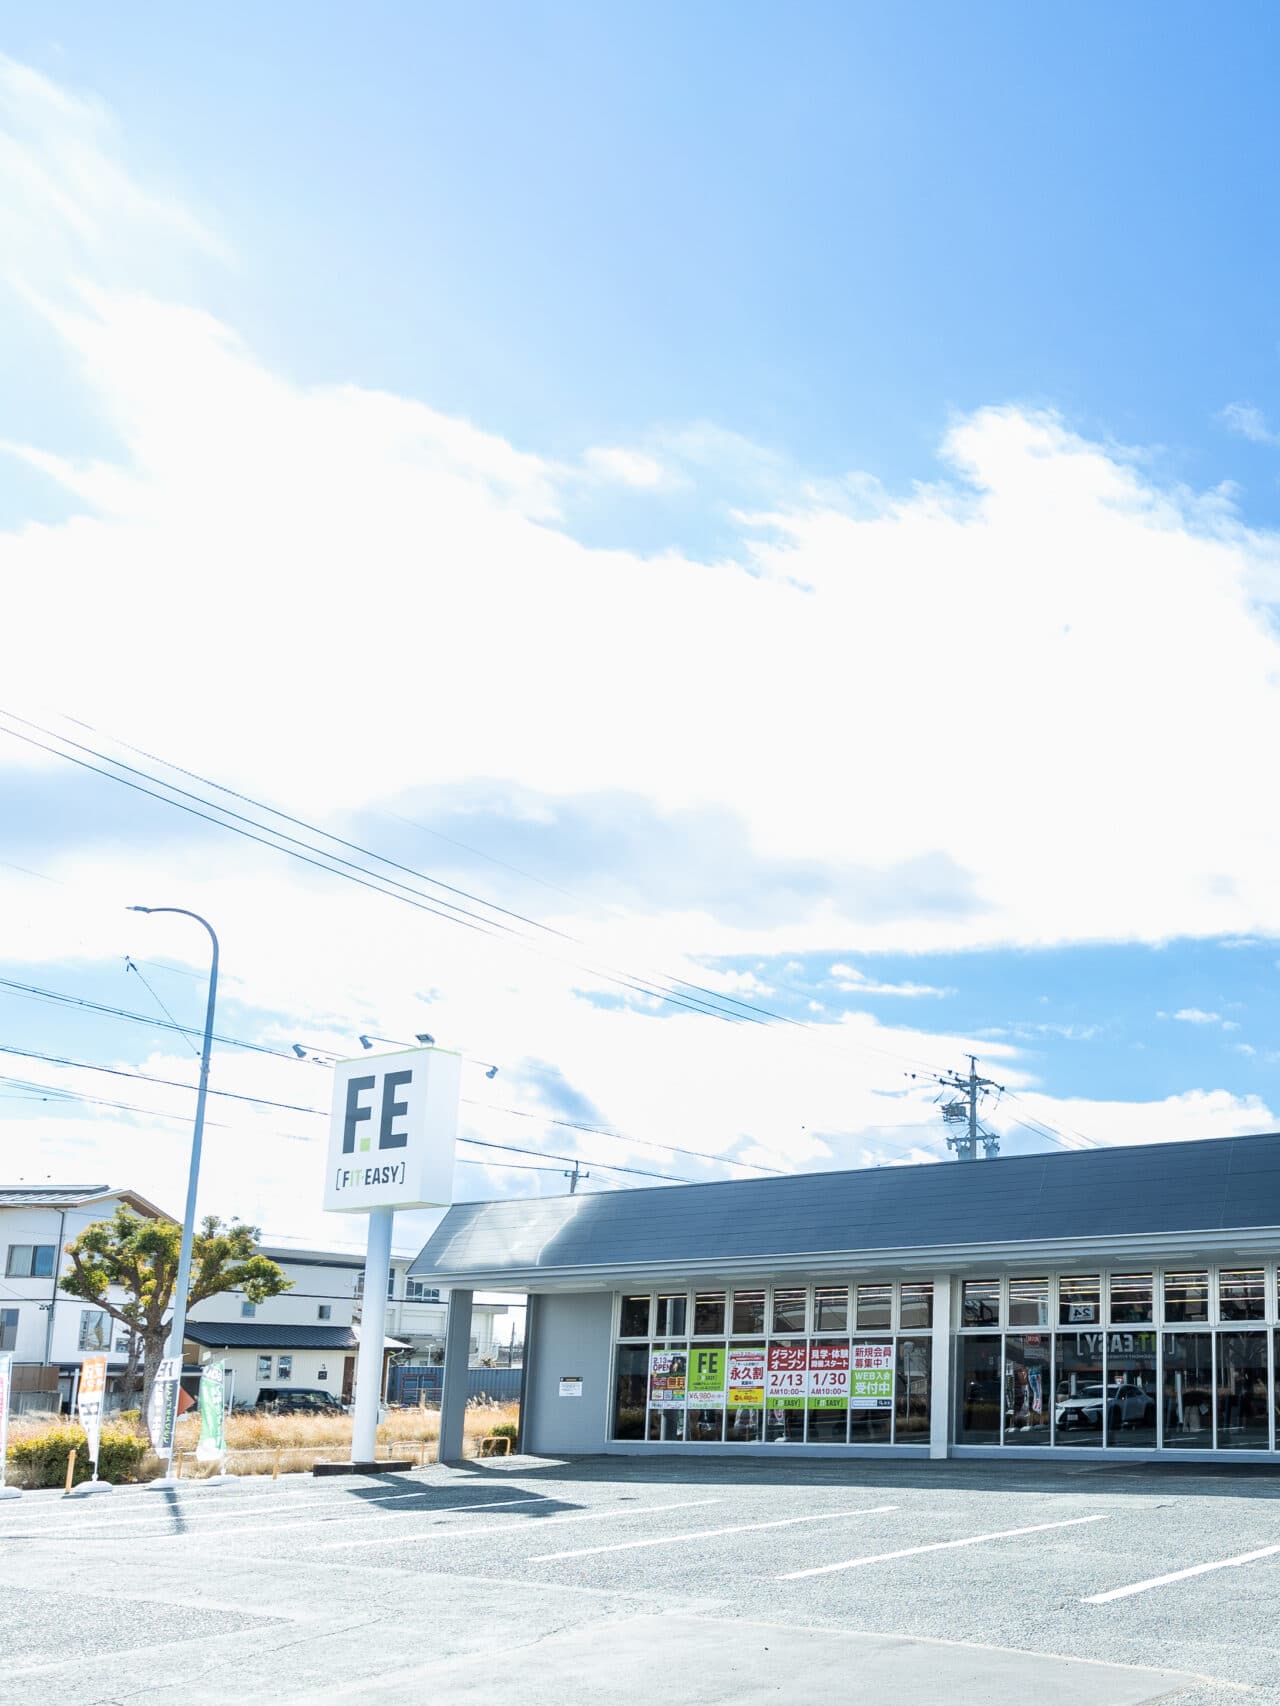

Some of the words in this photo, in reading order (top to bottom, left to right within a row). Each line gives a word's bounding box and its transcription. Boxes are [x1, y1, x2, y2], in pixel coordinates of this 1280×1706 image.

[771, 1349, 805, 1360] グランド
[855, 1346, 892, 1358] 新規会員
[771, 1360, 805, 1370] オープン
[730, 1366, 764, 1380] 永久割
[770, 1373, 803, 1387] 2/13
[813, 1372, 847, 1386] 1/30
[855, 1381, 891, 1395] 受付中
